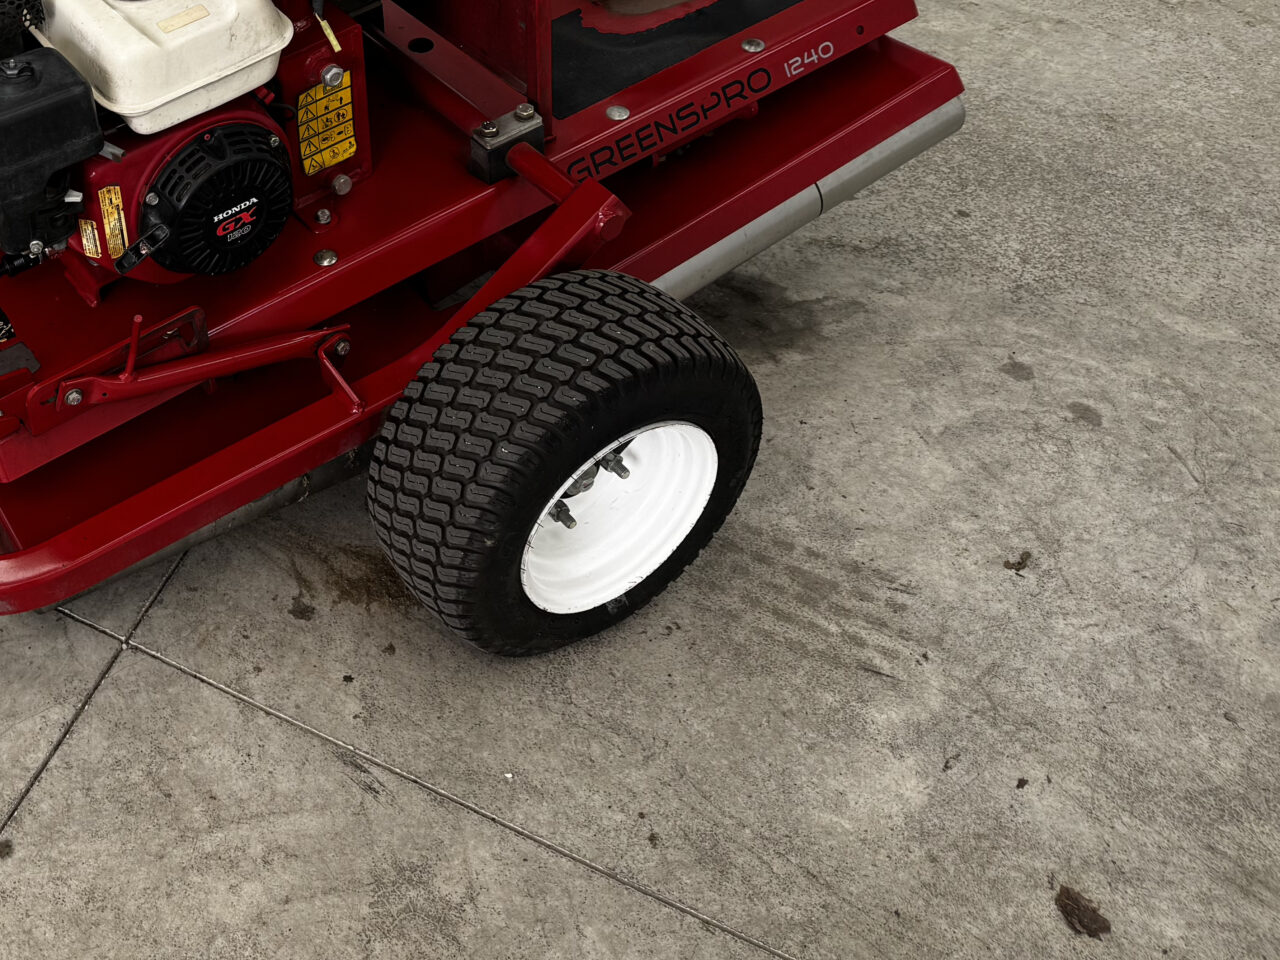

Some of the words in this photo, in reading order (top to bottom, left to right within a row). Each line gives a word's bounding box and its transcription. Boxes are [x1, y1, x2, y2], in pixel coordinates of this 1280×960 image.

[567, 67, 772, 184] GREENSPRO
[783, 41, 834, 78] 1240
[213, 197, 259, 223] HONDA
[216, 206, 257, 237] GX
